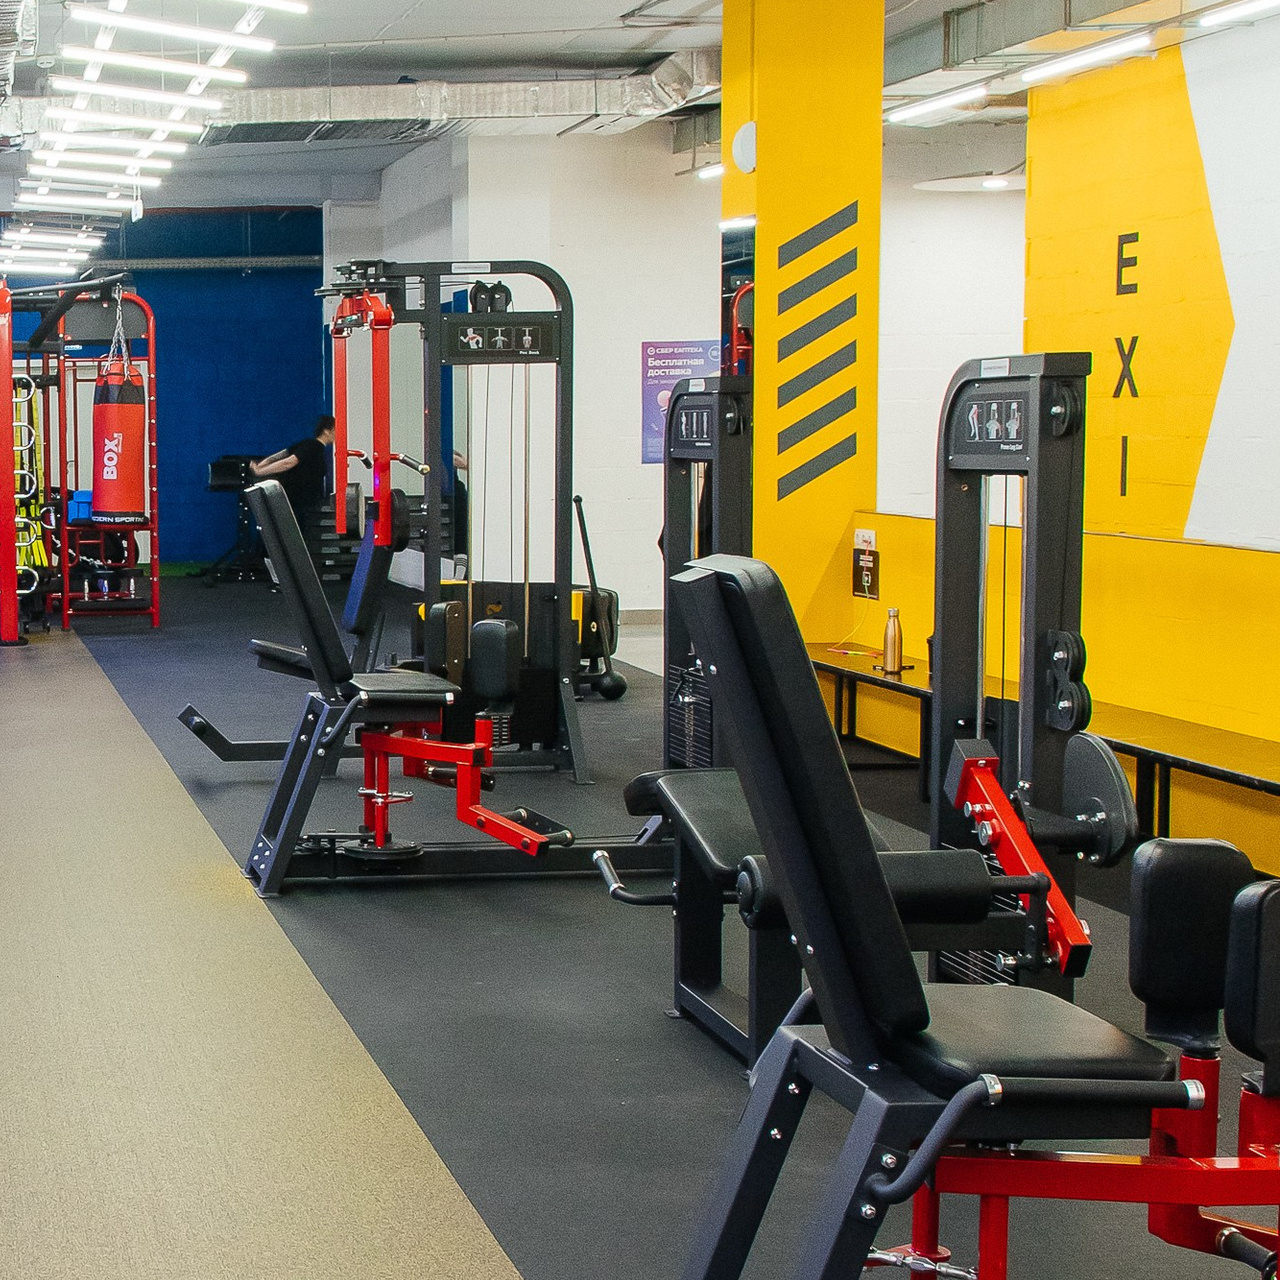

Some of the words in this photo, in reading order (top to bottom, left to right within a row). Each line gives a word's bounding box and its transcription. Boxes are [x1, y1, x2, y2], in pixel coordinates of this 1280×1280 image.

[647, 357, 705, 367] Бесплатная
[647, 368, 692, 377] доставка
[102, 437, 119, 480] BOX
